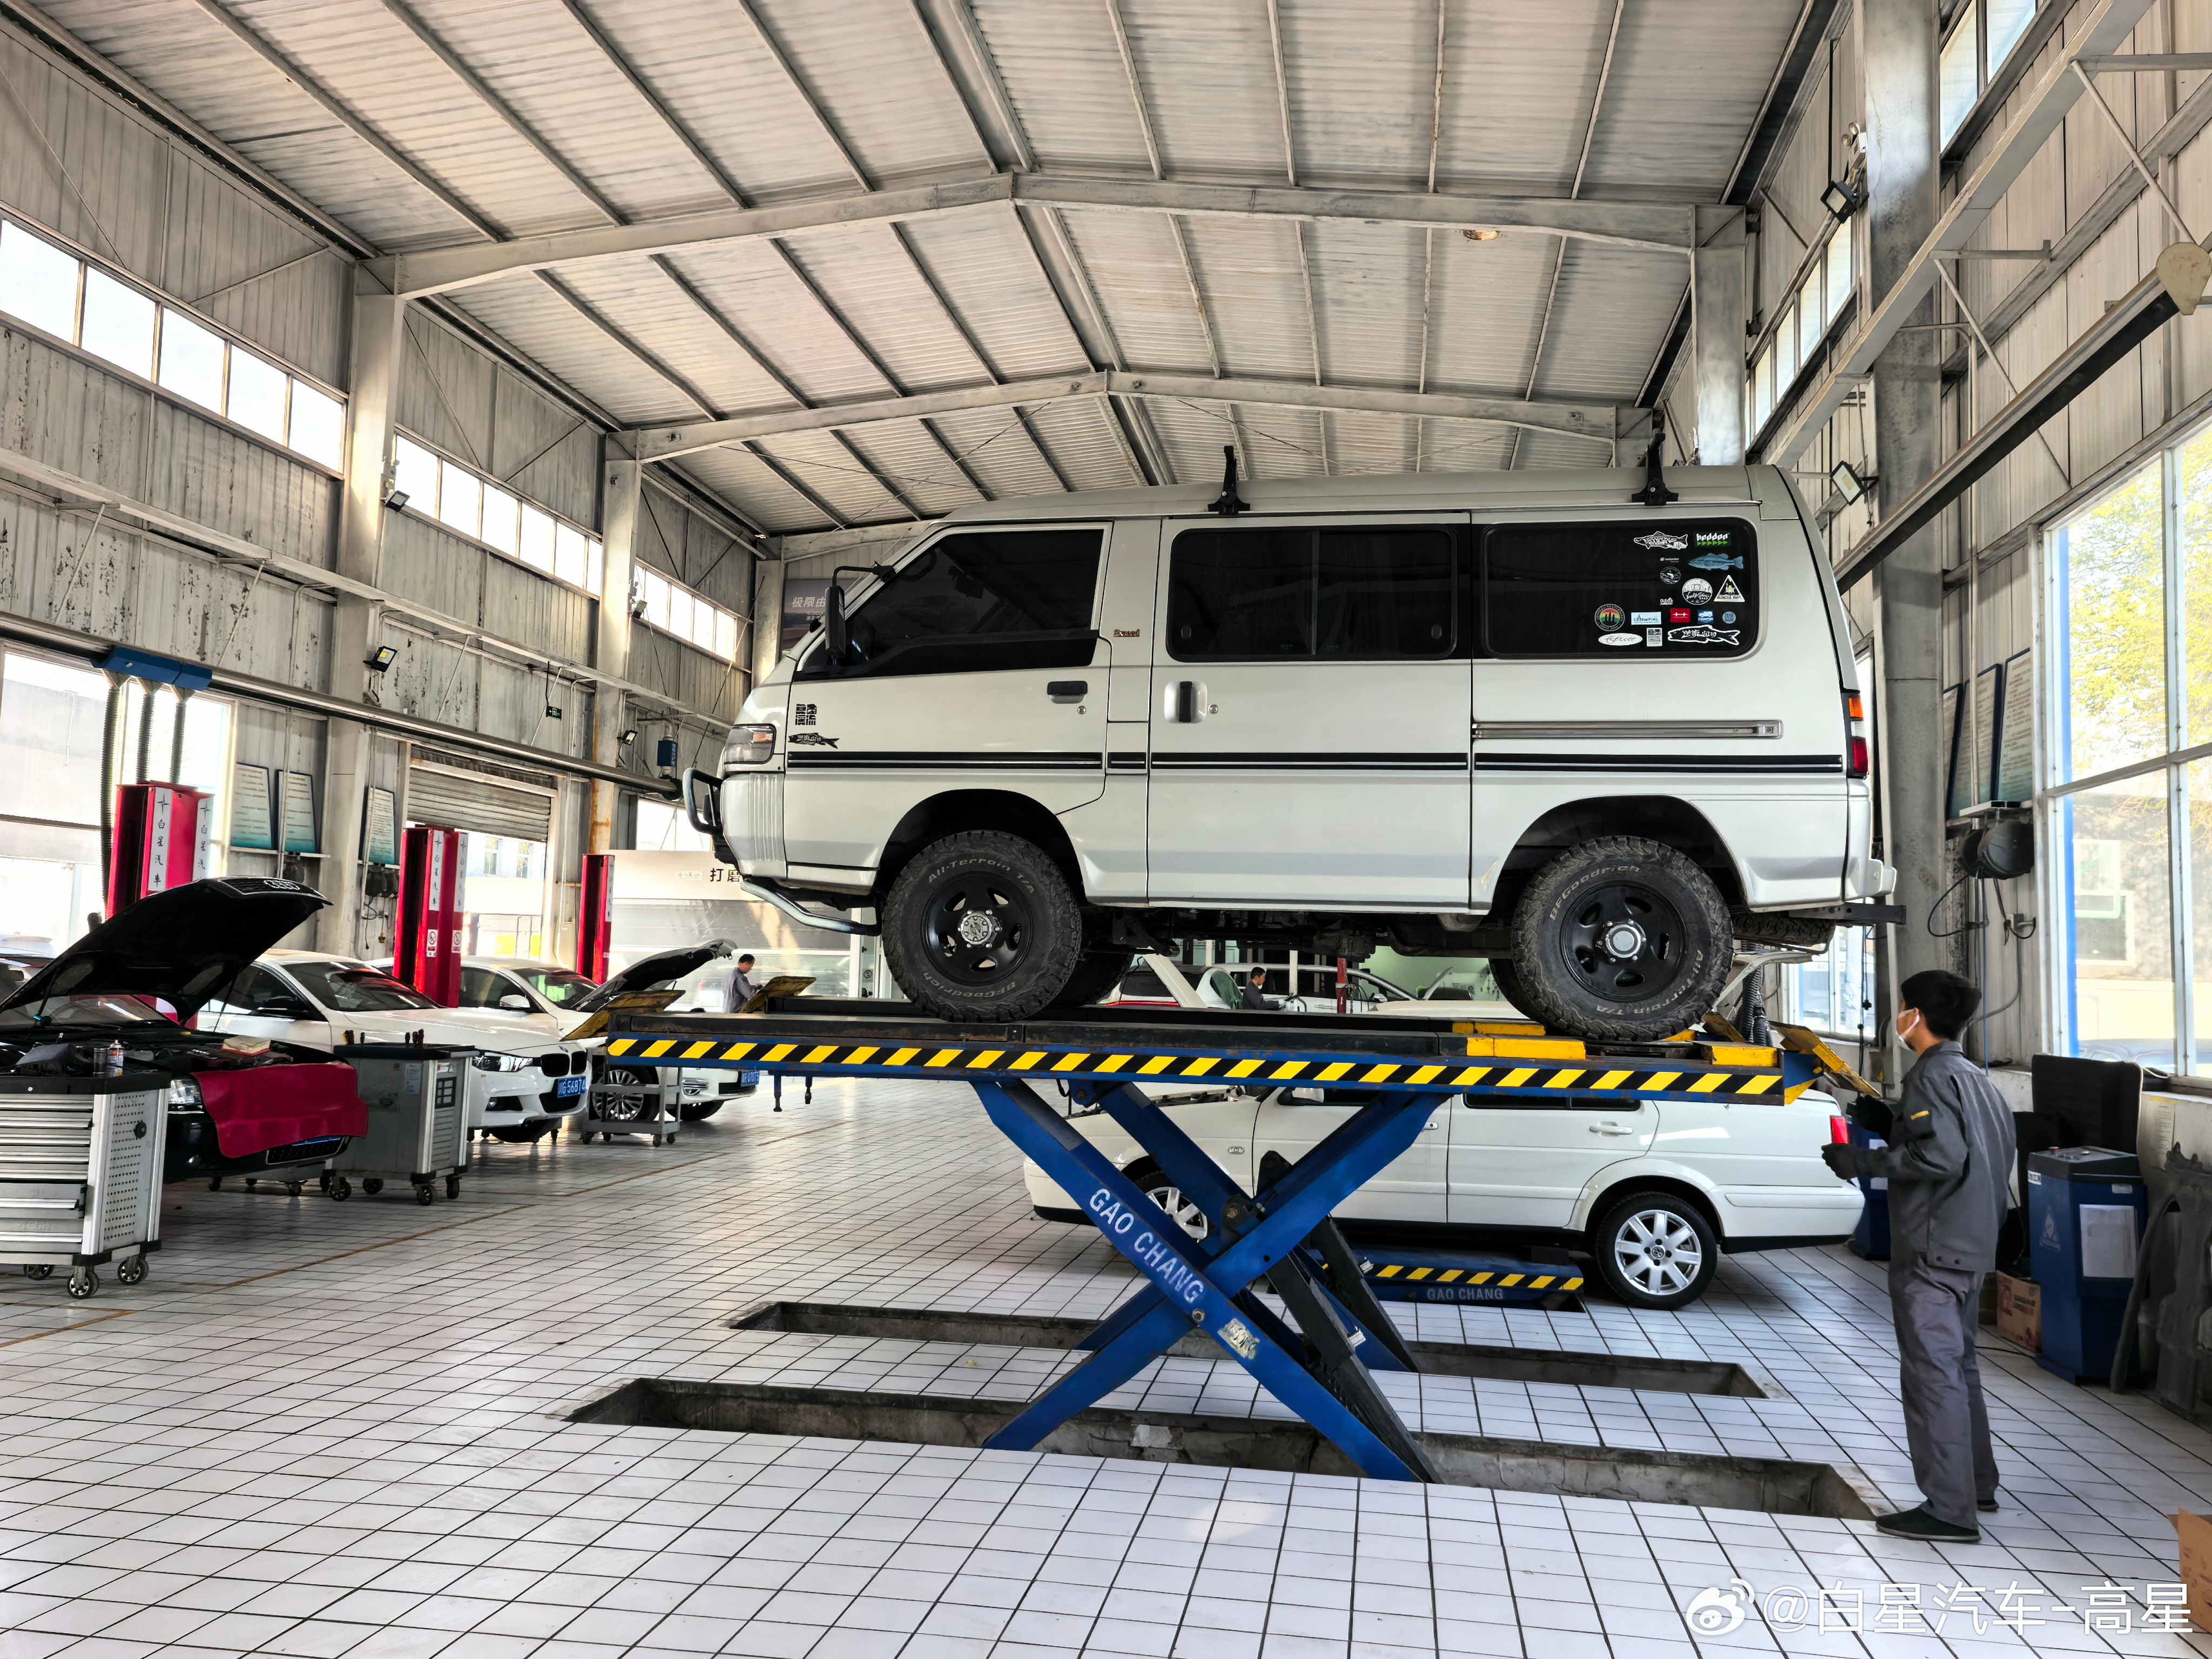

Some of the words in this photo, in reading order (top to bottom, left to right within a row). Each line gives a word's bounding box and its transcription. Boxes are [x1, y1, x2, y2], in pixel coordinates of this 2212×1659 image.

[1696, 532, 1728, 541] heddon
[198, 824, 208, 880] 白星汽
[928, 858, 1011, 884] All-Terrain
[1016, 872, 1035, 894] T/A
[1549, 865, 1640, 921] BFGoodrich
[923, 972, 1016, 998] BFGoodrich
[1634, 949, 1704, 1014] All-Terrain
[1088, 1188, 1135, 1235] GAO
[1133, 1232, 1205, 1305] CHANG
[1427, 1287, 1455, 1301] GAO
[1458, 1287, 1504, 1301] CHANG
